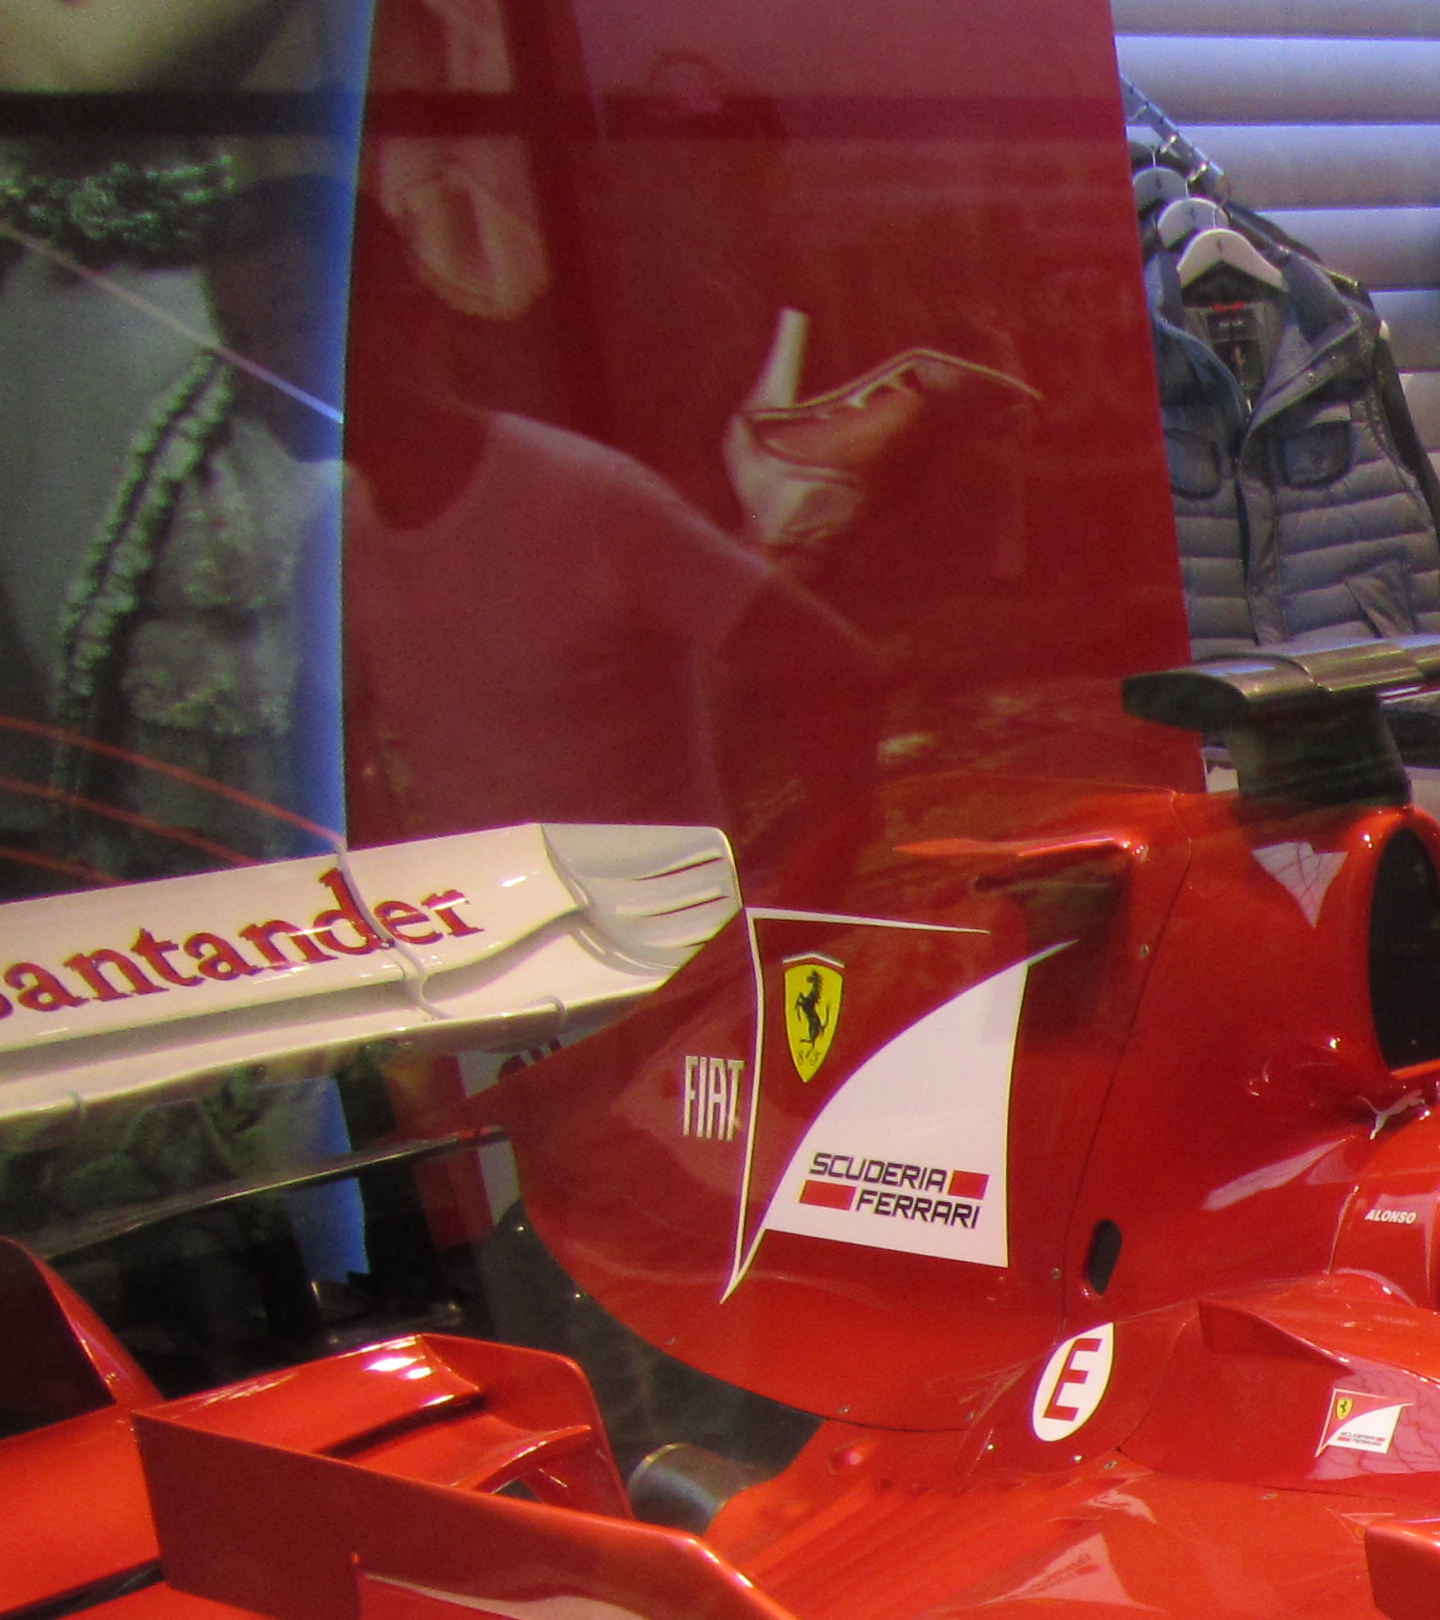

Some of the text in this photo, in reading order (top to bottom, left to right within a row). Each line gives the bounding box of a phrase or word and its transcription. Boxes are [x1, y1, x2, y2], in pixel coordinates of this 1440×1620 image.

[0, 866, 485, 1020] antander
[682, 1055, 745, 1142] FIAT
[809, 1151, 949, 1194] SCUDERIA
[856, 1188, 981, 1229] FERRARI
[1365, 1208, 1418, 1225] ALONSO
[1042, 1337, 1103, 1422] E
